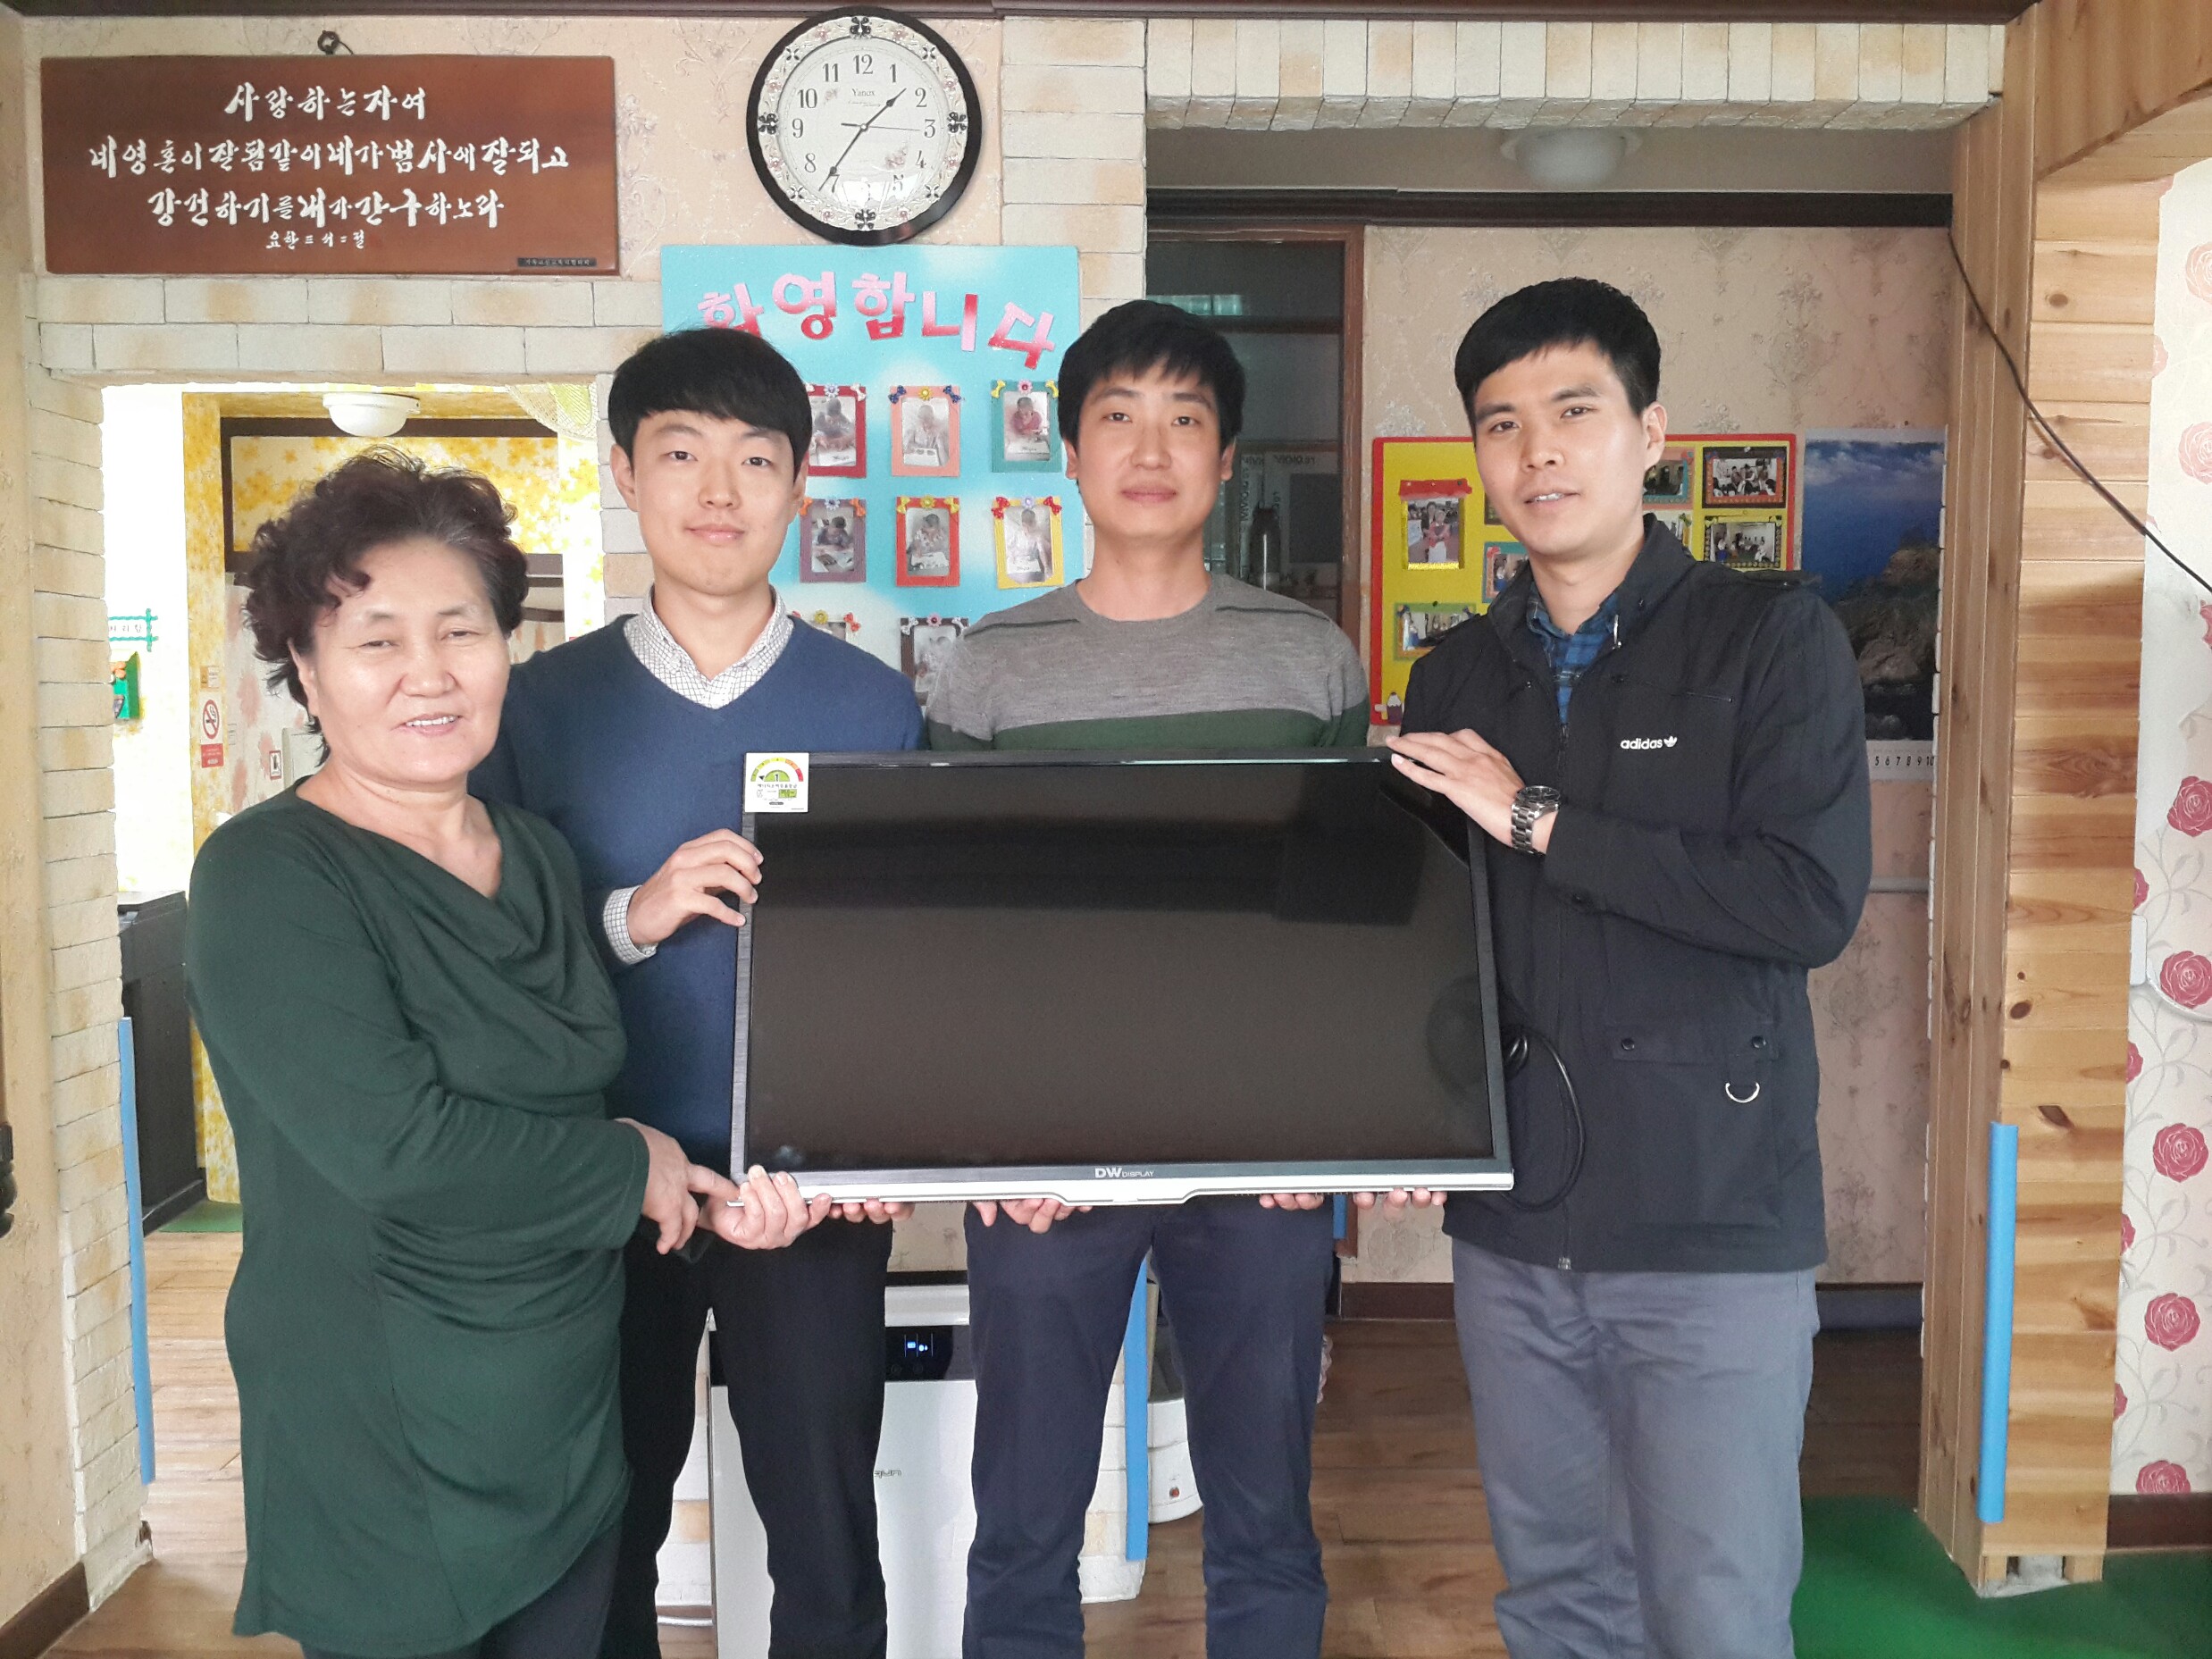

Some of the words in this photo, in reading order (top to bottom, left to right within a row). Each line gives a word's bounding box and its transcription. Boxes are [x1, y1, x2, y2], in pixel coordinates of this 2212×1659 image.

[822, 63, 840, 83] 11
[852, 54, 874, 75] 12
[889, 63, 897, 83] 1
[797, 88, 818, 109] 10
[915, 88, 927, 108] 2
[792, 119, 804, 138] 9
[924, 119, 936, 138] 3
[804, 153, 817, 173] 8
[915, 150, 926, 169] 4
[827, 174, 840, 193] 7
[892, 174, 904, 191] 5
[1620, 737, 1663, 750] adidas
[1875, 756, 1880, 766] 5
[1885, 756, 1889, 766] 6
[1896, 756, 1900, 766] 7
[1906, 756, 1911, 767] 8
[1917, 756, 1922, 767] 9
